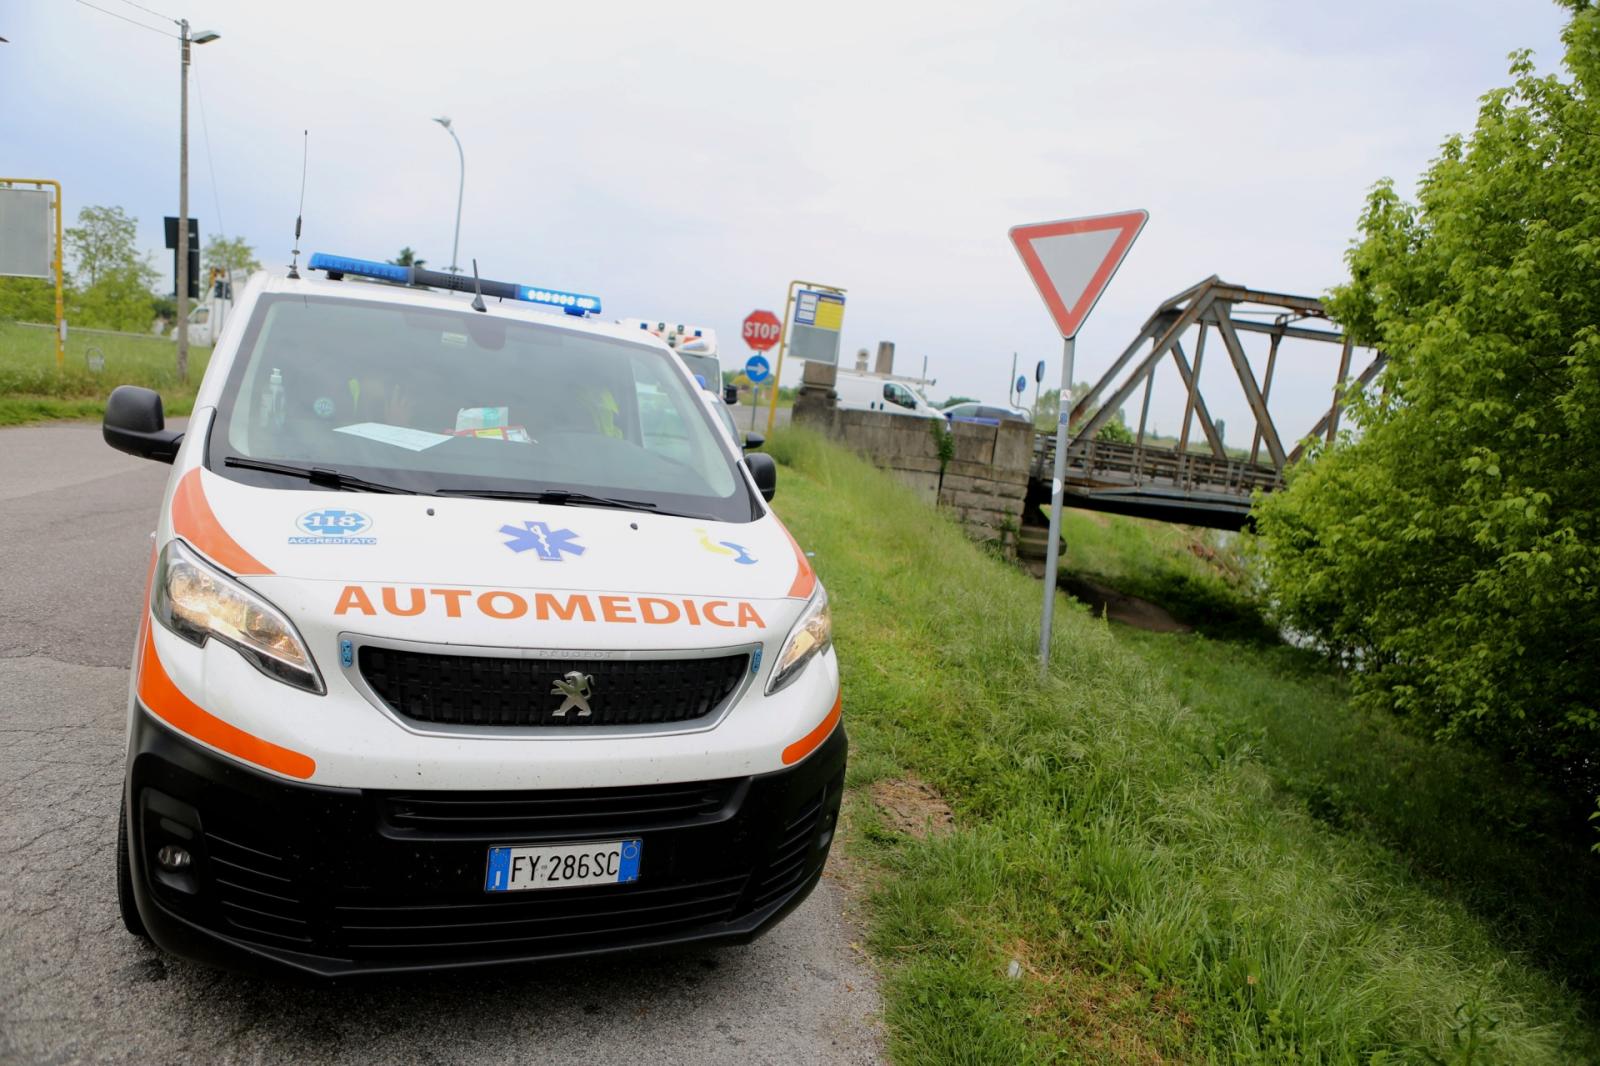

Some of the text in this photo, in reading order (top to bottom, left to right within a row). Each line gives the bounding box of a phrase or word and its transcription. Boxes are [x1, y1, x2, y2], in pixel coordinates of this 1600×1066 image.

[744, 321, 780, 340] STOP
[311, 515, 356, 527] 118
[288, 536, 377, 545] ACCREDITATO
[333, 585, 766, 629] AUTOMEDICA
